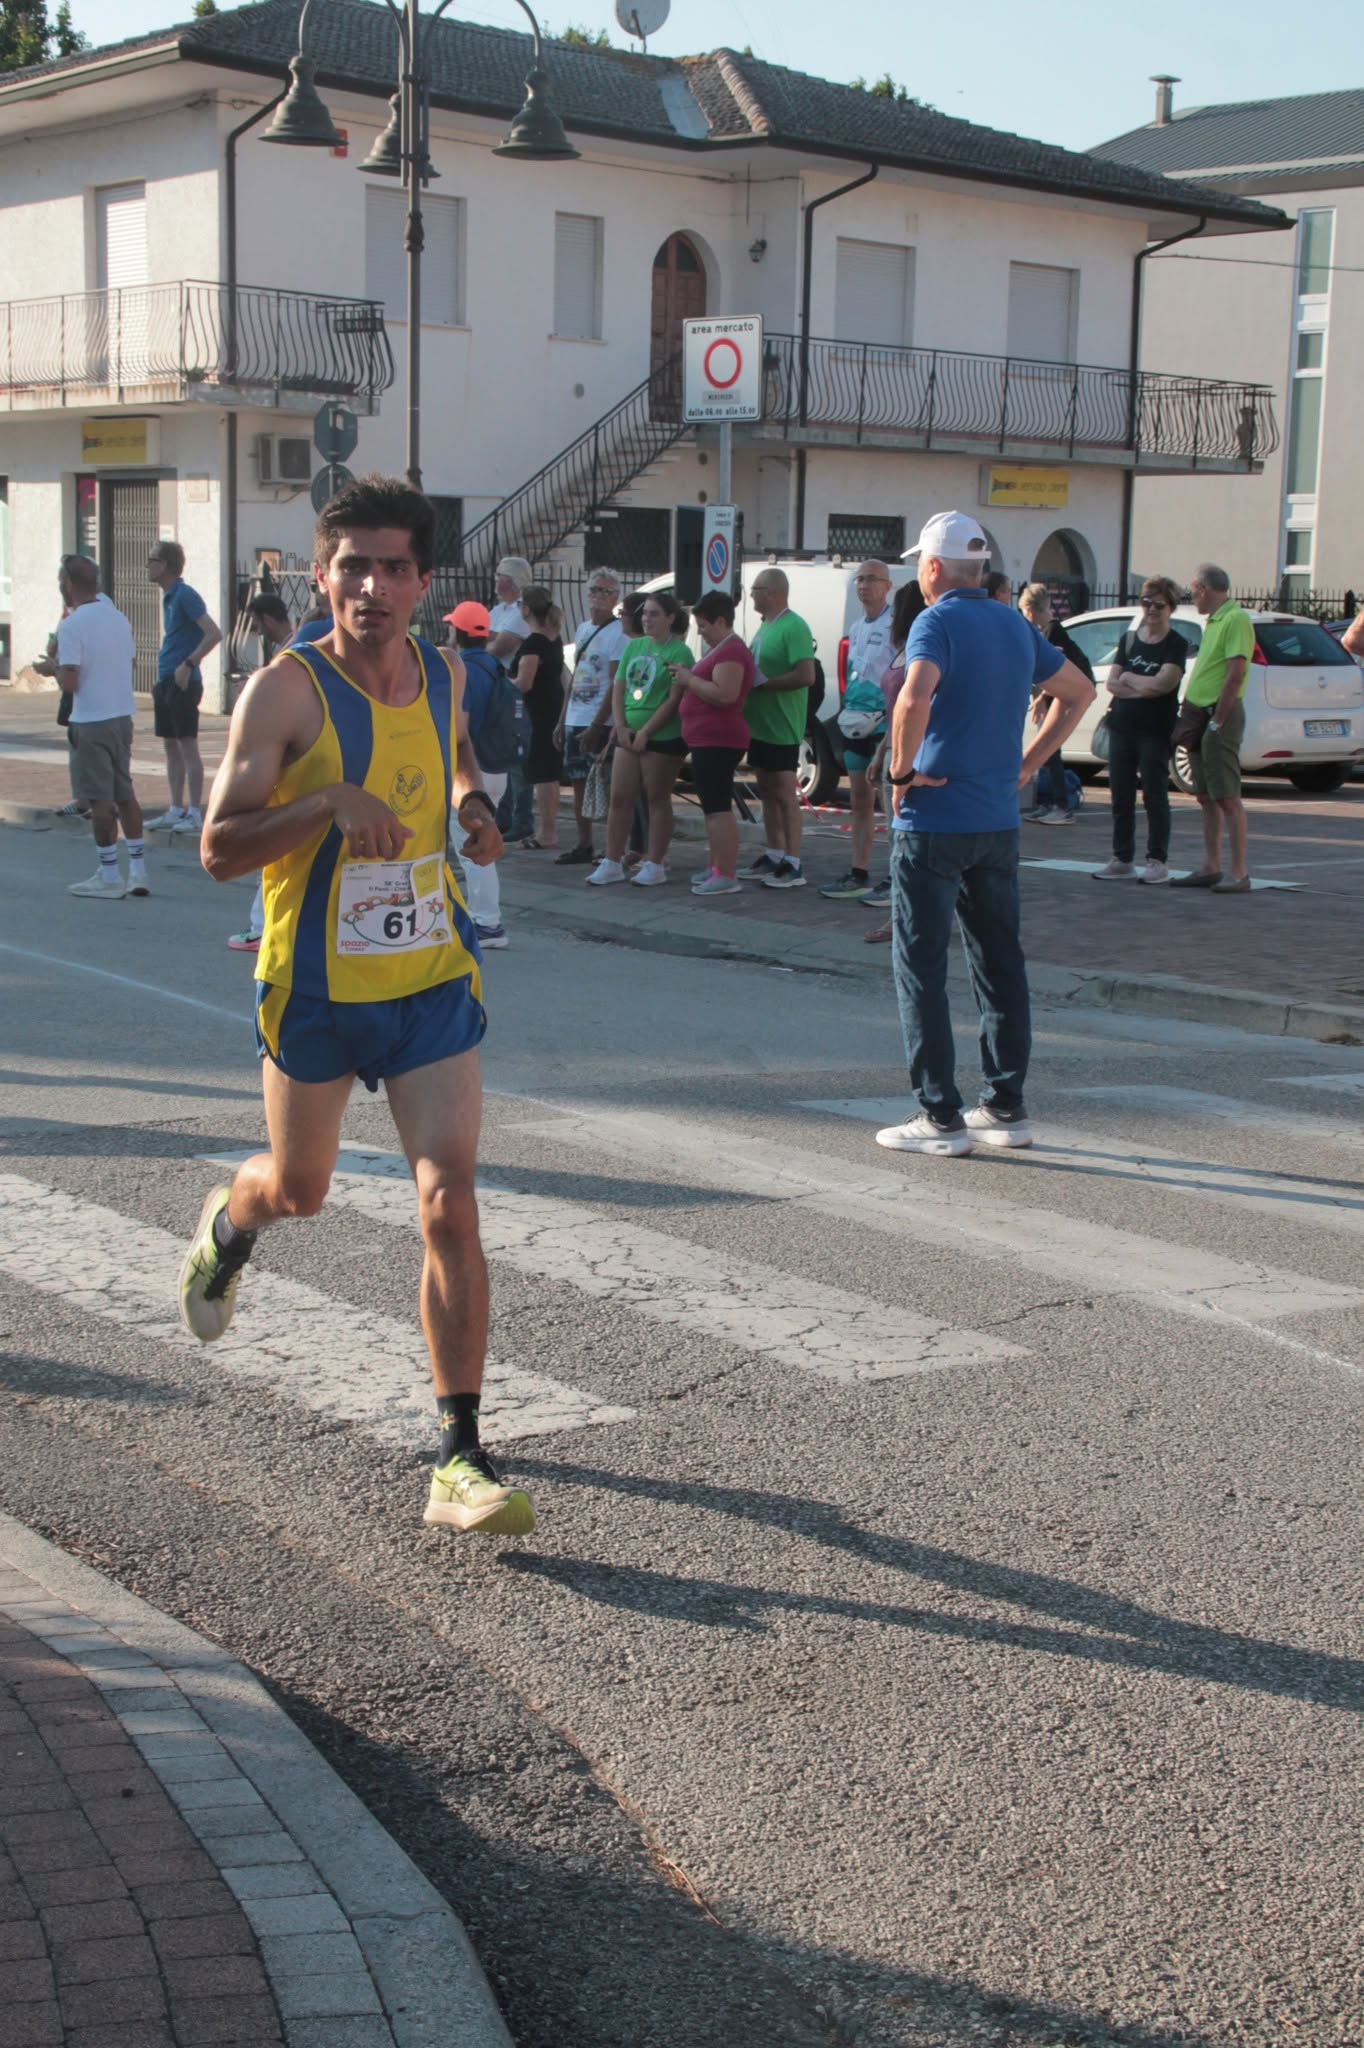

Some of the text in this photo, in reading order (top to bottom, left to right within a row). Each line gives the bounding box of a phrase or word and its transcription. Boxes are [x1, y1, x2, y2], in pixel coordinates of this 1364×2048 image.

[691, 322, 754, 334] area mercato
[688, 408, 704, 416] dalle
[726, 407, 738, 415] alle
[383, 908, 417, 940] 61
